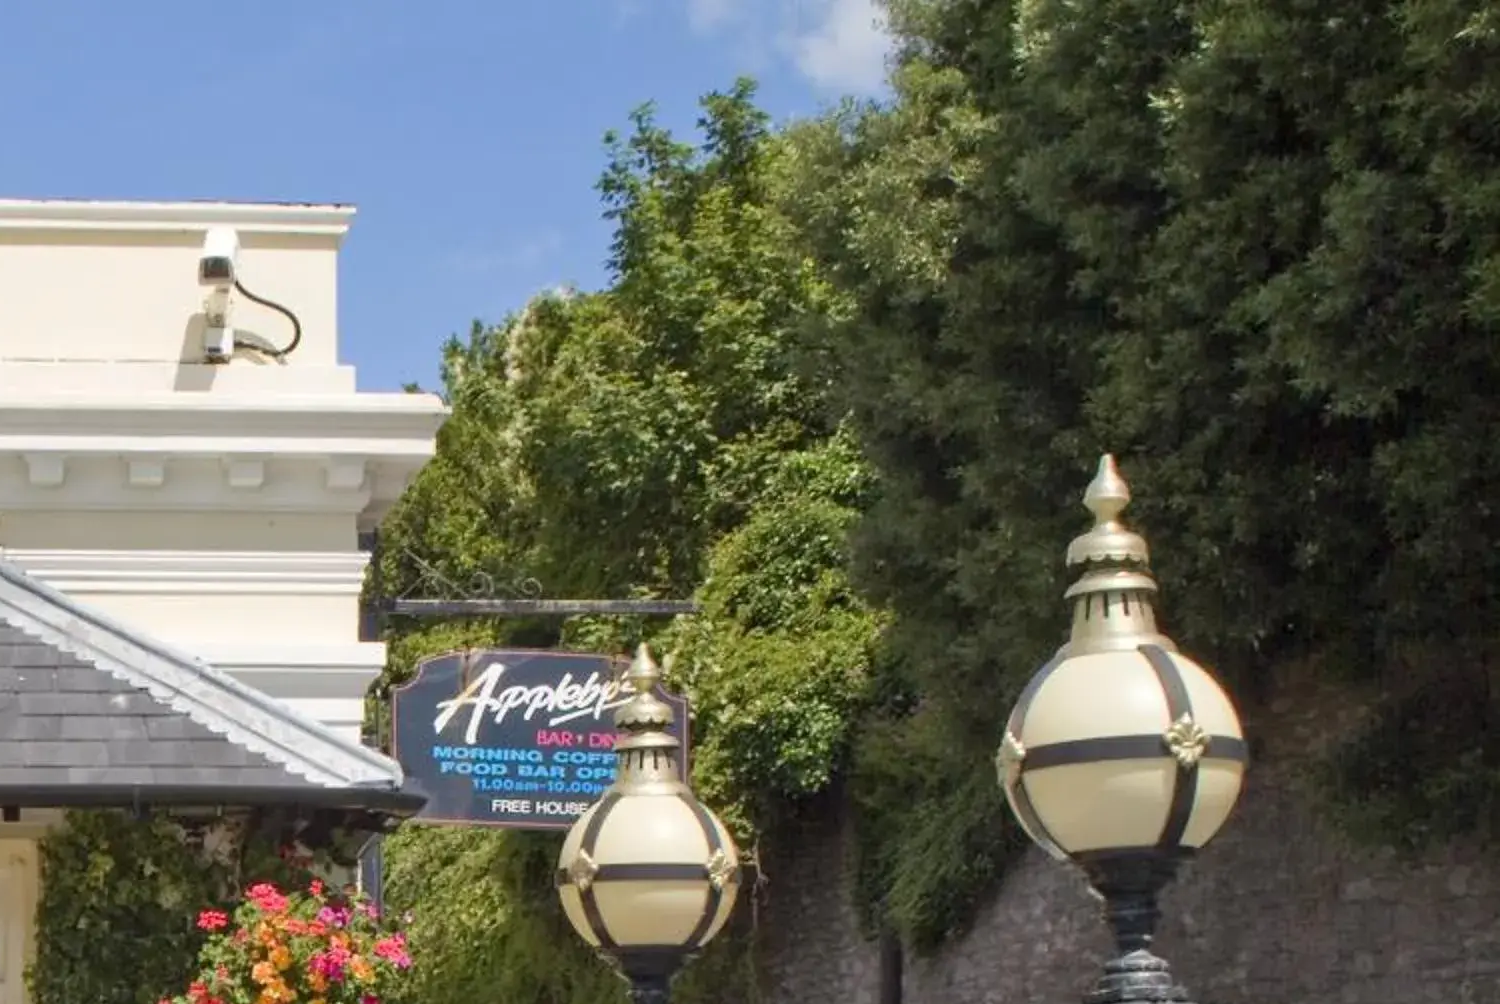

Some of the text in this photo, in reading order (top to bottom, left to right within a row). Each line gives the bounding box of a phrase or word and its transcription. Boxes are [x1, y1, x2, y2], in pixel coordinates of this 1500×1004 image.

[536, 730, 572, 747] BAR
[433, 746, 620, 765] MORNING COFF
[440, 761, 507, 777] FOOD
[518, 764, 565, 778] BAR
[472, 778, 606, 795] 11.00am-10.00p
[491, 799, 589, 815] FREE HOUSE
